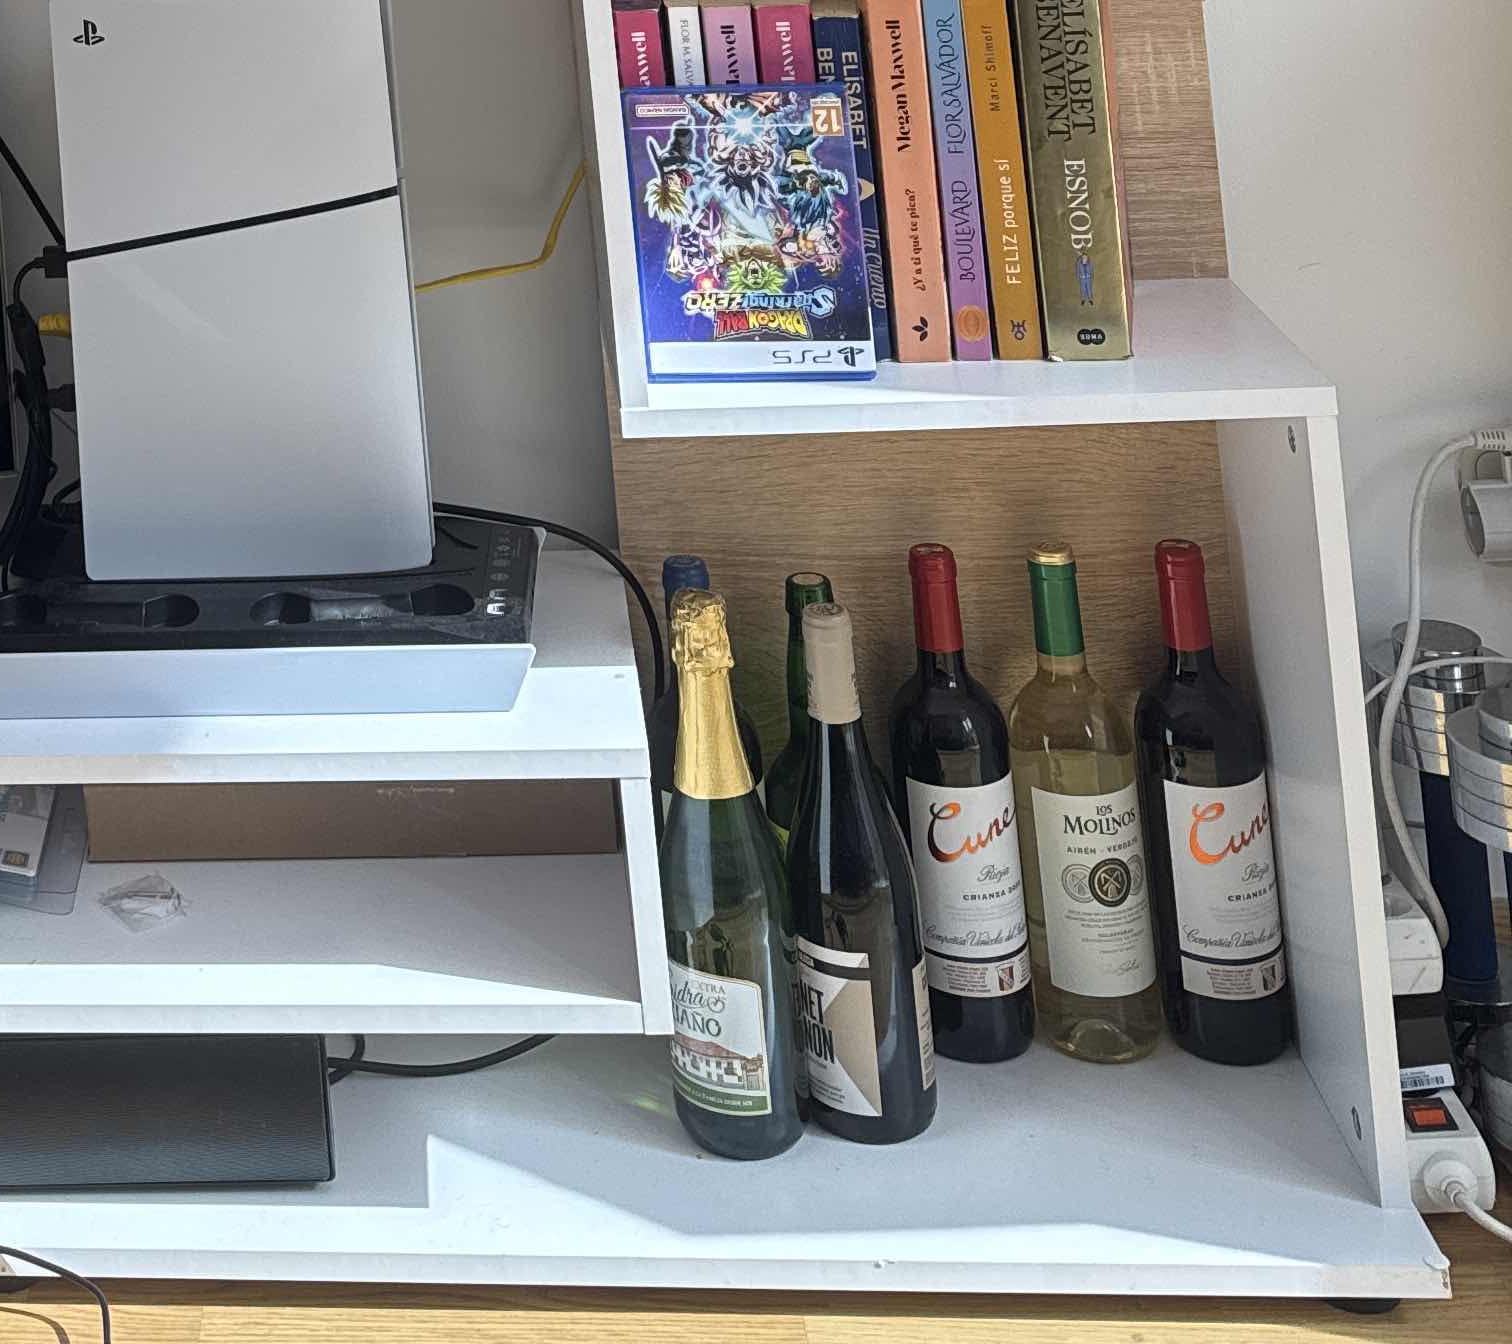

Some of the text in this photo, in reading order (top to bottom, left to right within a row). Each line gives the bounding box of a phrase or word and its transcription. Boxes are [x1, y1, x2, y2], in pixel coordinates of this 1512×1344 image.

[679, 19, 689, 45] FLOR
[631, 31, 651, 88] axwell
[683, 58, 695, 86] SALVA
[981, 24, 1001, 113] Marci Shimoff
[885, 19, 913, 153] Megan Maxwell
[813, 109, 840, 133] 12
[934, 13, 975, 282] BOULEVARD FLOR SALVADOR
[904, 188, 921, 219] pica?
[1062, 158, 1094, 251] ESNOB
[908, 219, 919, 232] te
[993, 159, 1022, 285] FELIZ porque sí
[909, 232, 924, 255] qué
[910, 255, 921, 266] ti
[683, 290, 745, 313] ZERO
[717, 310, 809, 335] DRAGON BALL
[772, 350, 832, 365] PS5
[1063, 807, 1137, 836] MOLINOS
[1095, 804, 1113, 817] LOS
[927, 801, 1016, 864] Cune
[1066, 845, 1097, 855] AIRÉN
[976, 864, 1010, 883] Rioja
[962, 889, 1007, 902] CRIANZA
[1227, 888, 1268, 902] CRIANZA
[671, 981, 706, 1009] idra
[688, 978, 727, 995] EXTRA
[673, 1006, 722, 1037] IAÑO
